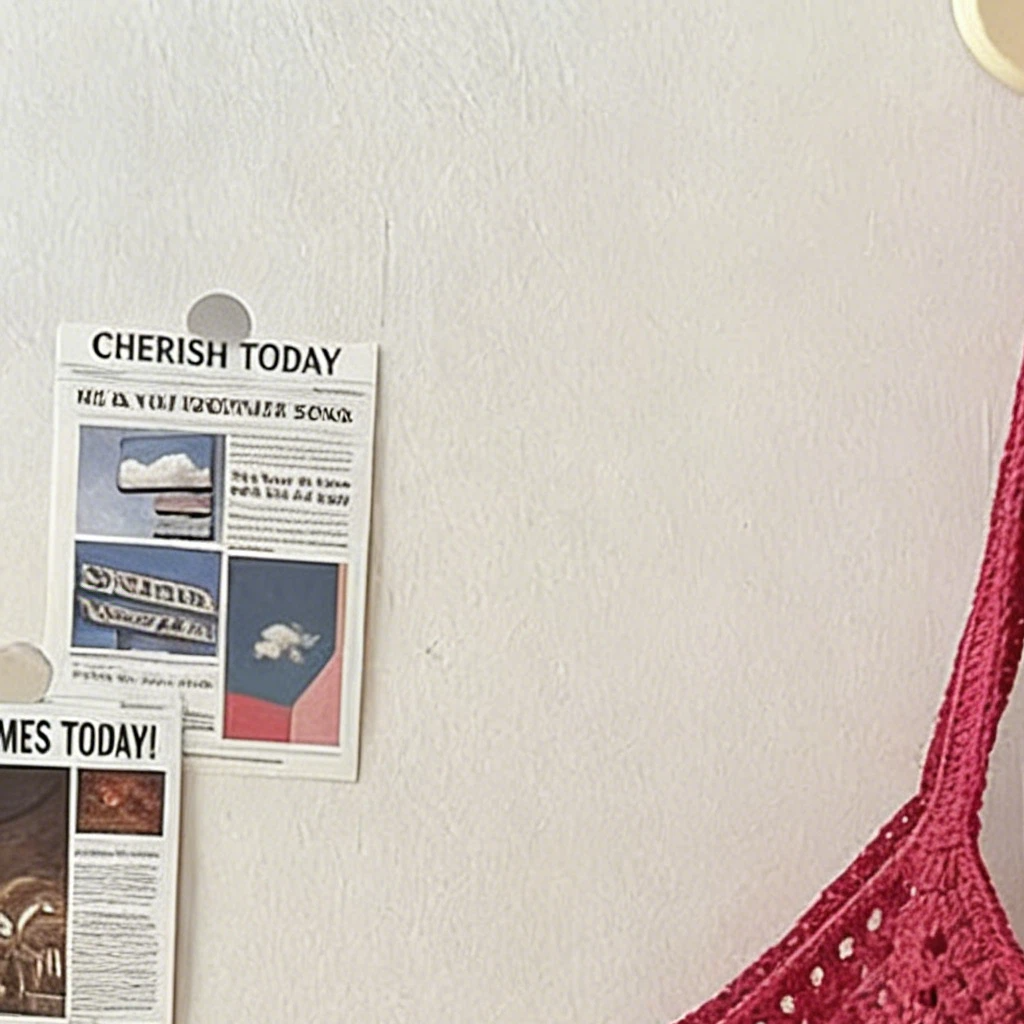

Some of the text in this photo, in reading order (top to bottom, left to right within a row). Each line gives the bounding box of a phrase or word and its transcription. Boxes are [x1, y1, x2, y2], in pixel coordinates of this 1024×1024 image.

[92, 331, 342, 375] CHERISH TODAY
[0, 719, 52, 754] MES
[60, 720, 157, 759] TODAY!
